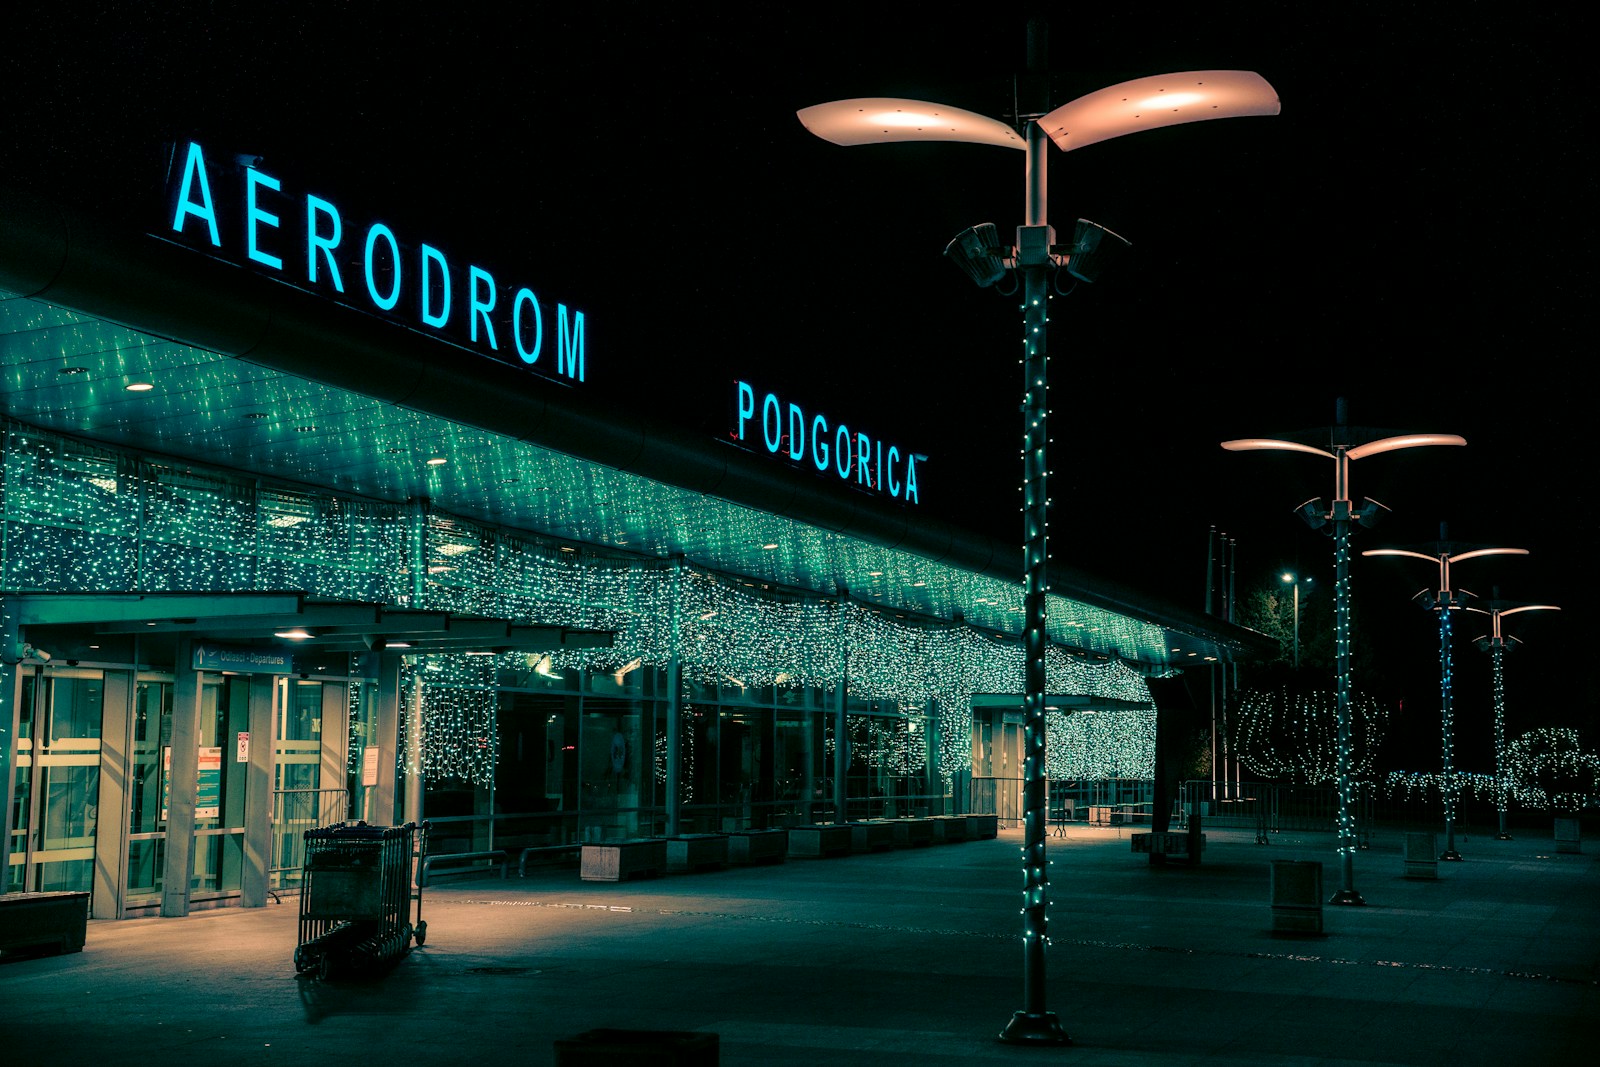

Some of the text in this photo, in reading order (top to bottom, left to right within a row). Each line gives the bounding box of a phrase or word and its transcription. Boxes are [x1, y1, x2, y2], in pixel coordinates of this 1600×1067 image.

[171, 141, 921, 506] AERODROM PODGORICA
[250, 652, 284, 665] Departures
